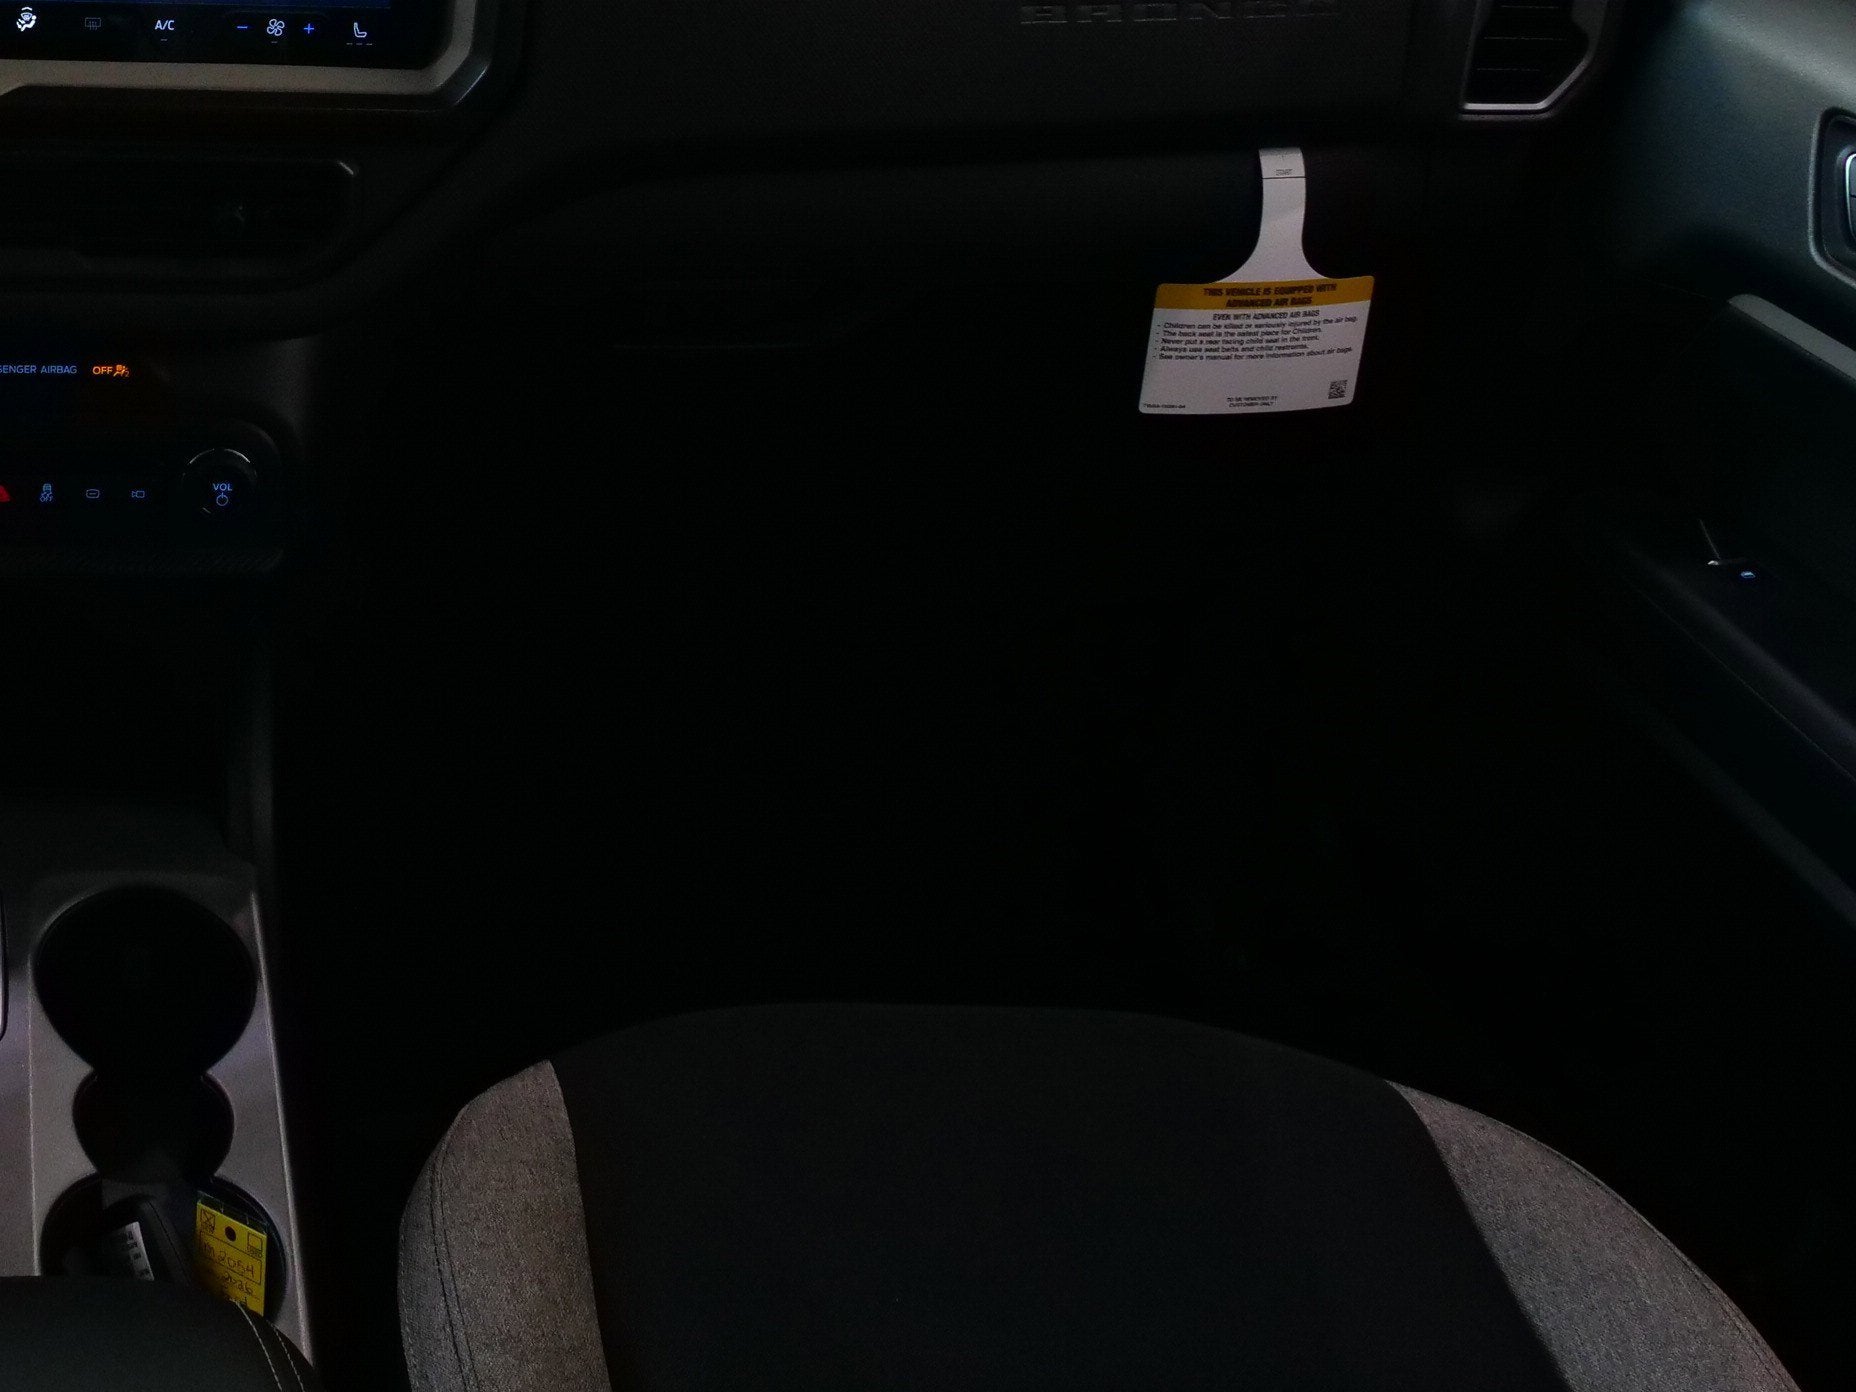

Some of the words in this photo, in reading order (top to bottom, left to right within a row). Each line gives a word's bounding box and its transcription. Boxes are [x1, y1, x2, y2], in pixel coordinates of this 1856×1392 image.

[154, 19, 175, 32] A/C
[1204, 288, 1223, 296] THIS
[1226, 288, 1261, 296] VEHICLE
[1274, 286, 1314, 294] EQUIPPED
[1226, 298, 1272, 307] ADVANCED
[1291, 297, 1312, 305] BAGS
[1253, 312, 1288, 320] ADVANCED
[1222, 338, 1244, 346] facing
[40, 364, 78, 375] AIRBAG
[92, 365, 113, 376] OFF
[212, 482, 234, 492] VOL
